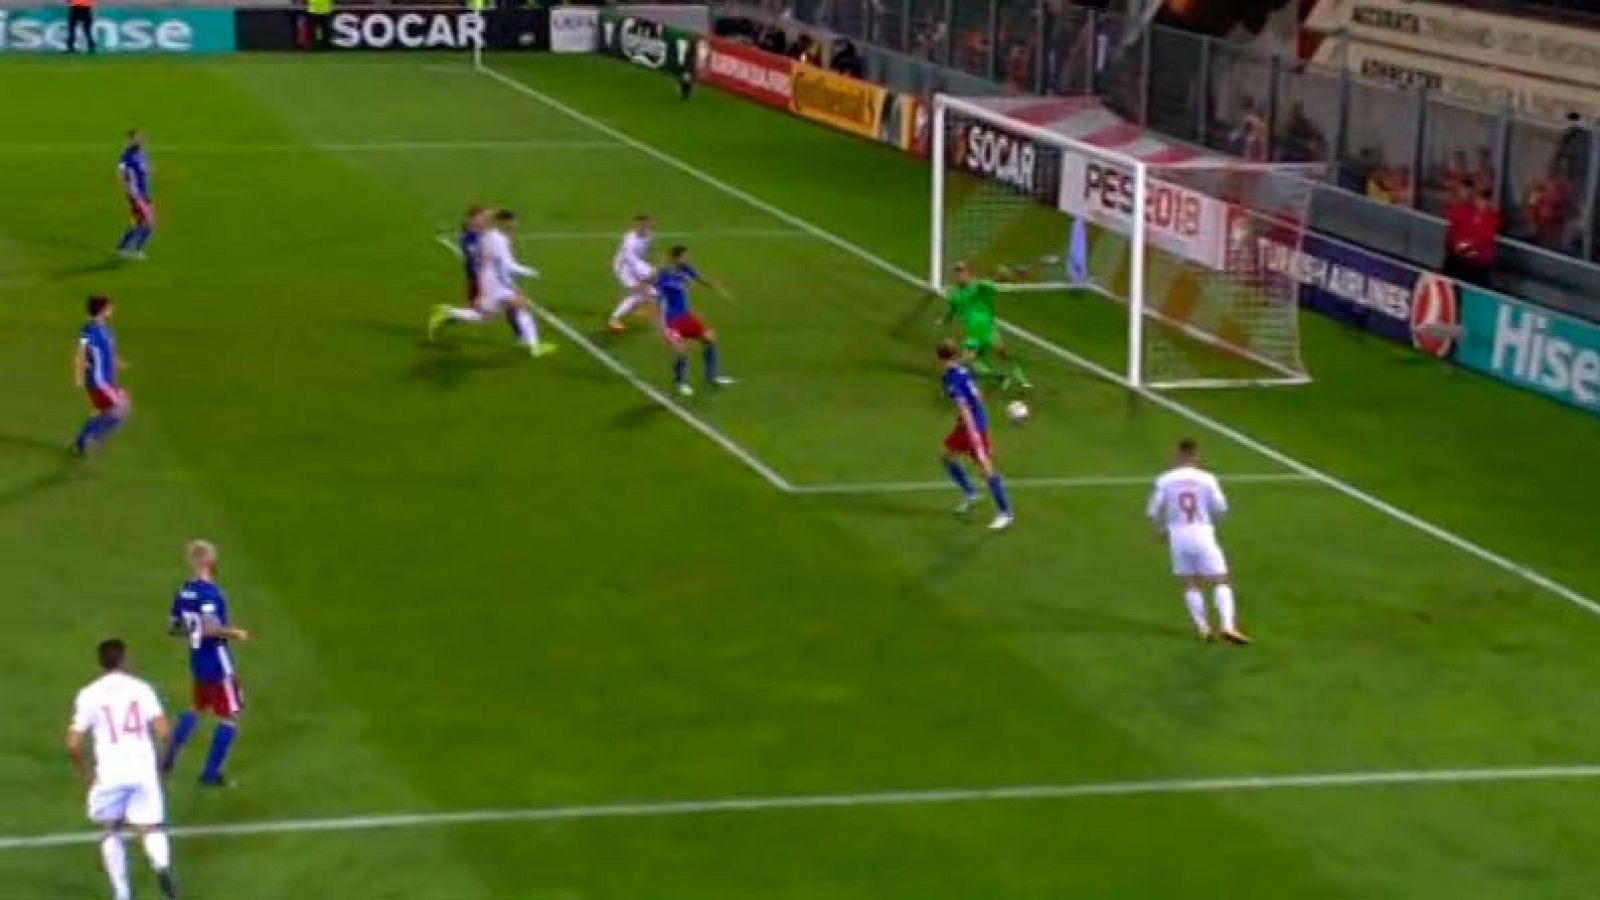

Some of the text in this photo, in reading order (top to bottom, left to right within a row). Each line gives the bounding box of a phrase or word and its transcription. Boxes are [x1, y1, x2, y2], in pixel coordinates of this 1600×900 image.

[332, 12, 486, 48] SOCAR
[966, 126, 1035, 194] SOCAR
[1330, 262, 1410, 321] AIRLINES
[1178, 491, 1198, 524] 9
[102, 699, 143, 744] 14
